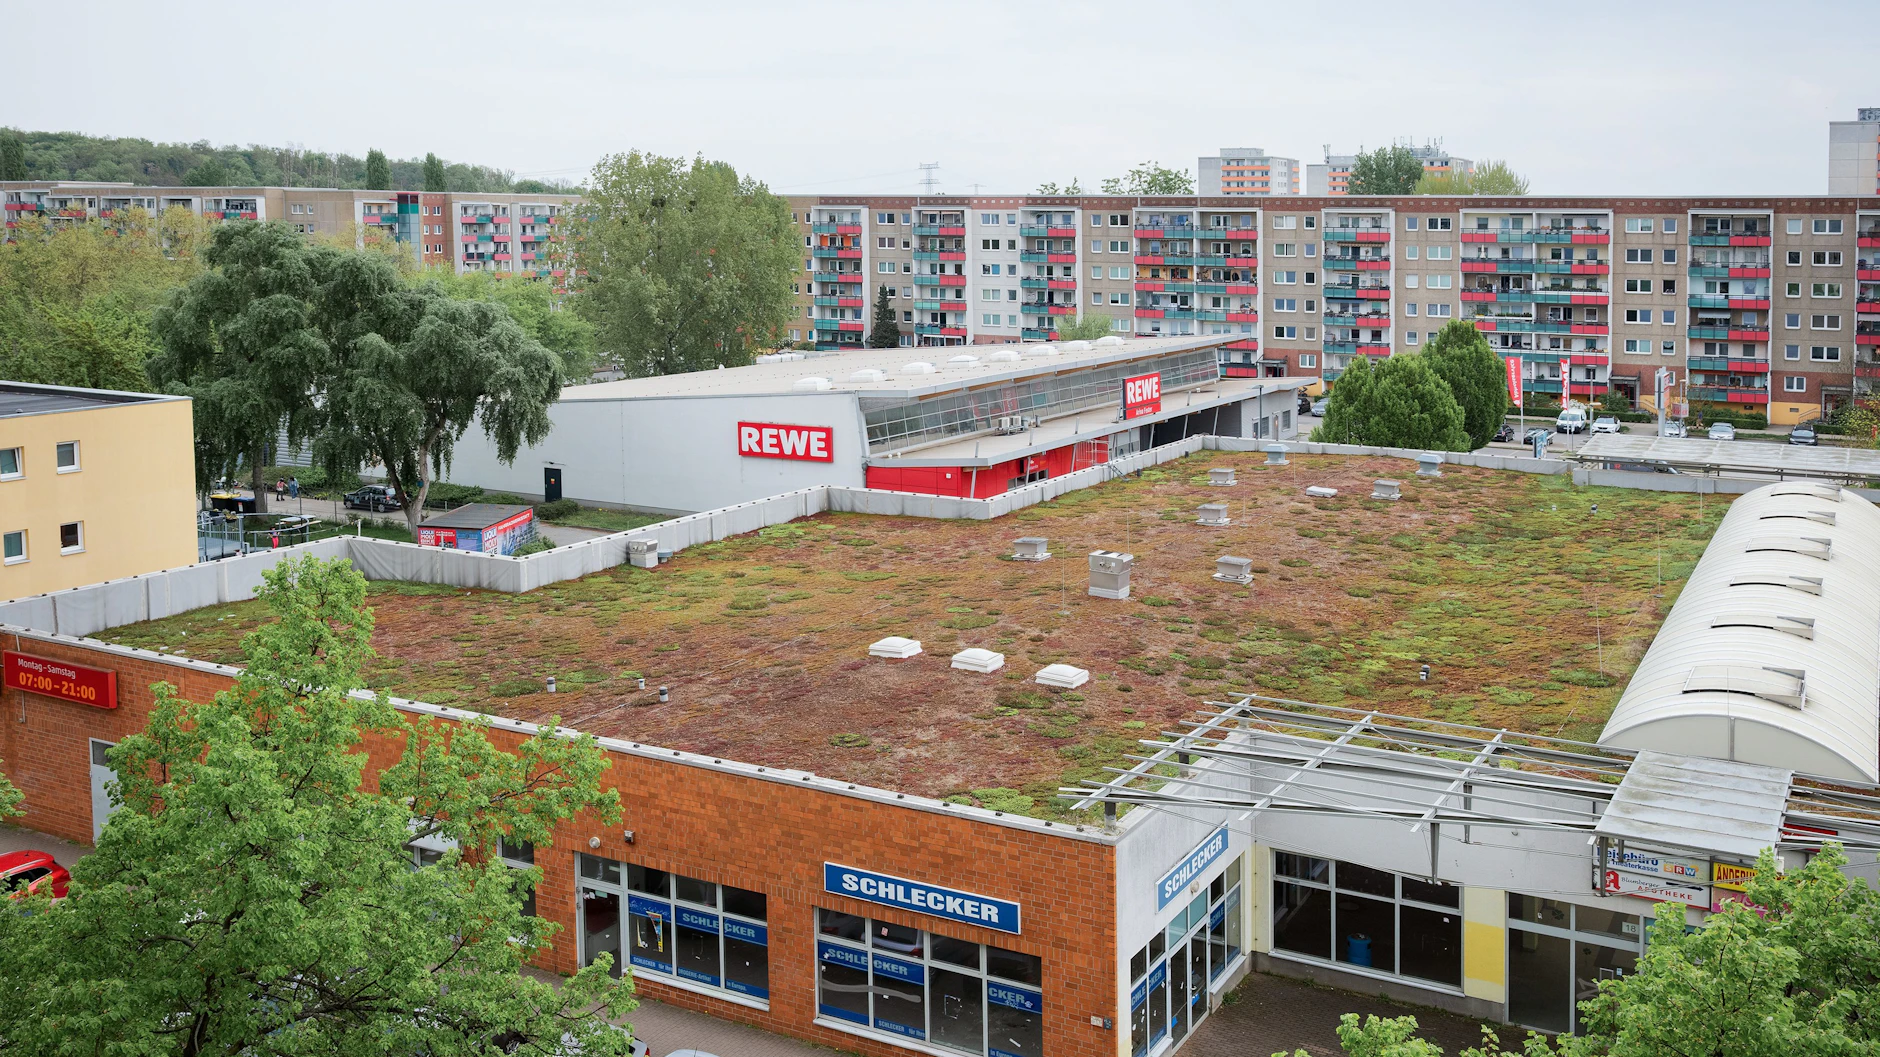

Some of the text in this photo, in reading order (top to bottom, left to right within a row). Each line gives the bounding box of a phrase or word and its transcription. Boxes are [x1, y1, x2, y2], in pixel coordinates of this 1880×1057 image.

[1127, 377, 1159, 404] REWE
[741, 426, 828, 458] REWE
[18, 658, 43, 673] Montag
[47, 664, 76, 679] Samstag
[19, 672, 52, 691] 07:00
[61, 681, 95, 700] 21:00
[1164, 834, 1223, 898] SCHLECKER
[1597, 846, 1659, 866] eiebüro
[1621, 876, 1660, 888] Blumberger
[1716, 864, 1757, 886] ÄNDERUN
[841, 873, 1000, 924] SCHLECKER
[1638, 885, 1693, 901] APOTHEKE
[682, 913, 756, 938] SCHLECKER
[1625, 924, 1637, 933] 18
[827, 948, 908, 976] SCHLECKER
[988, 987, 1025, 1004] CKER
